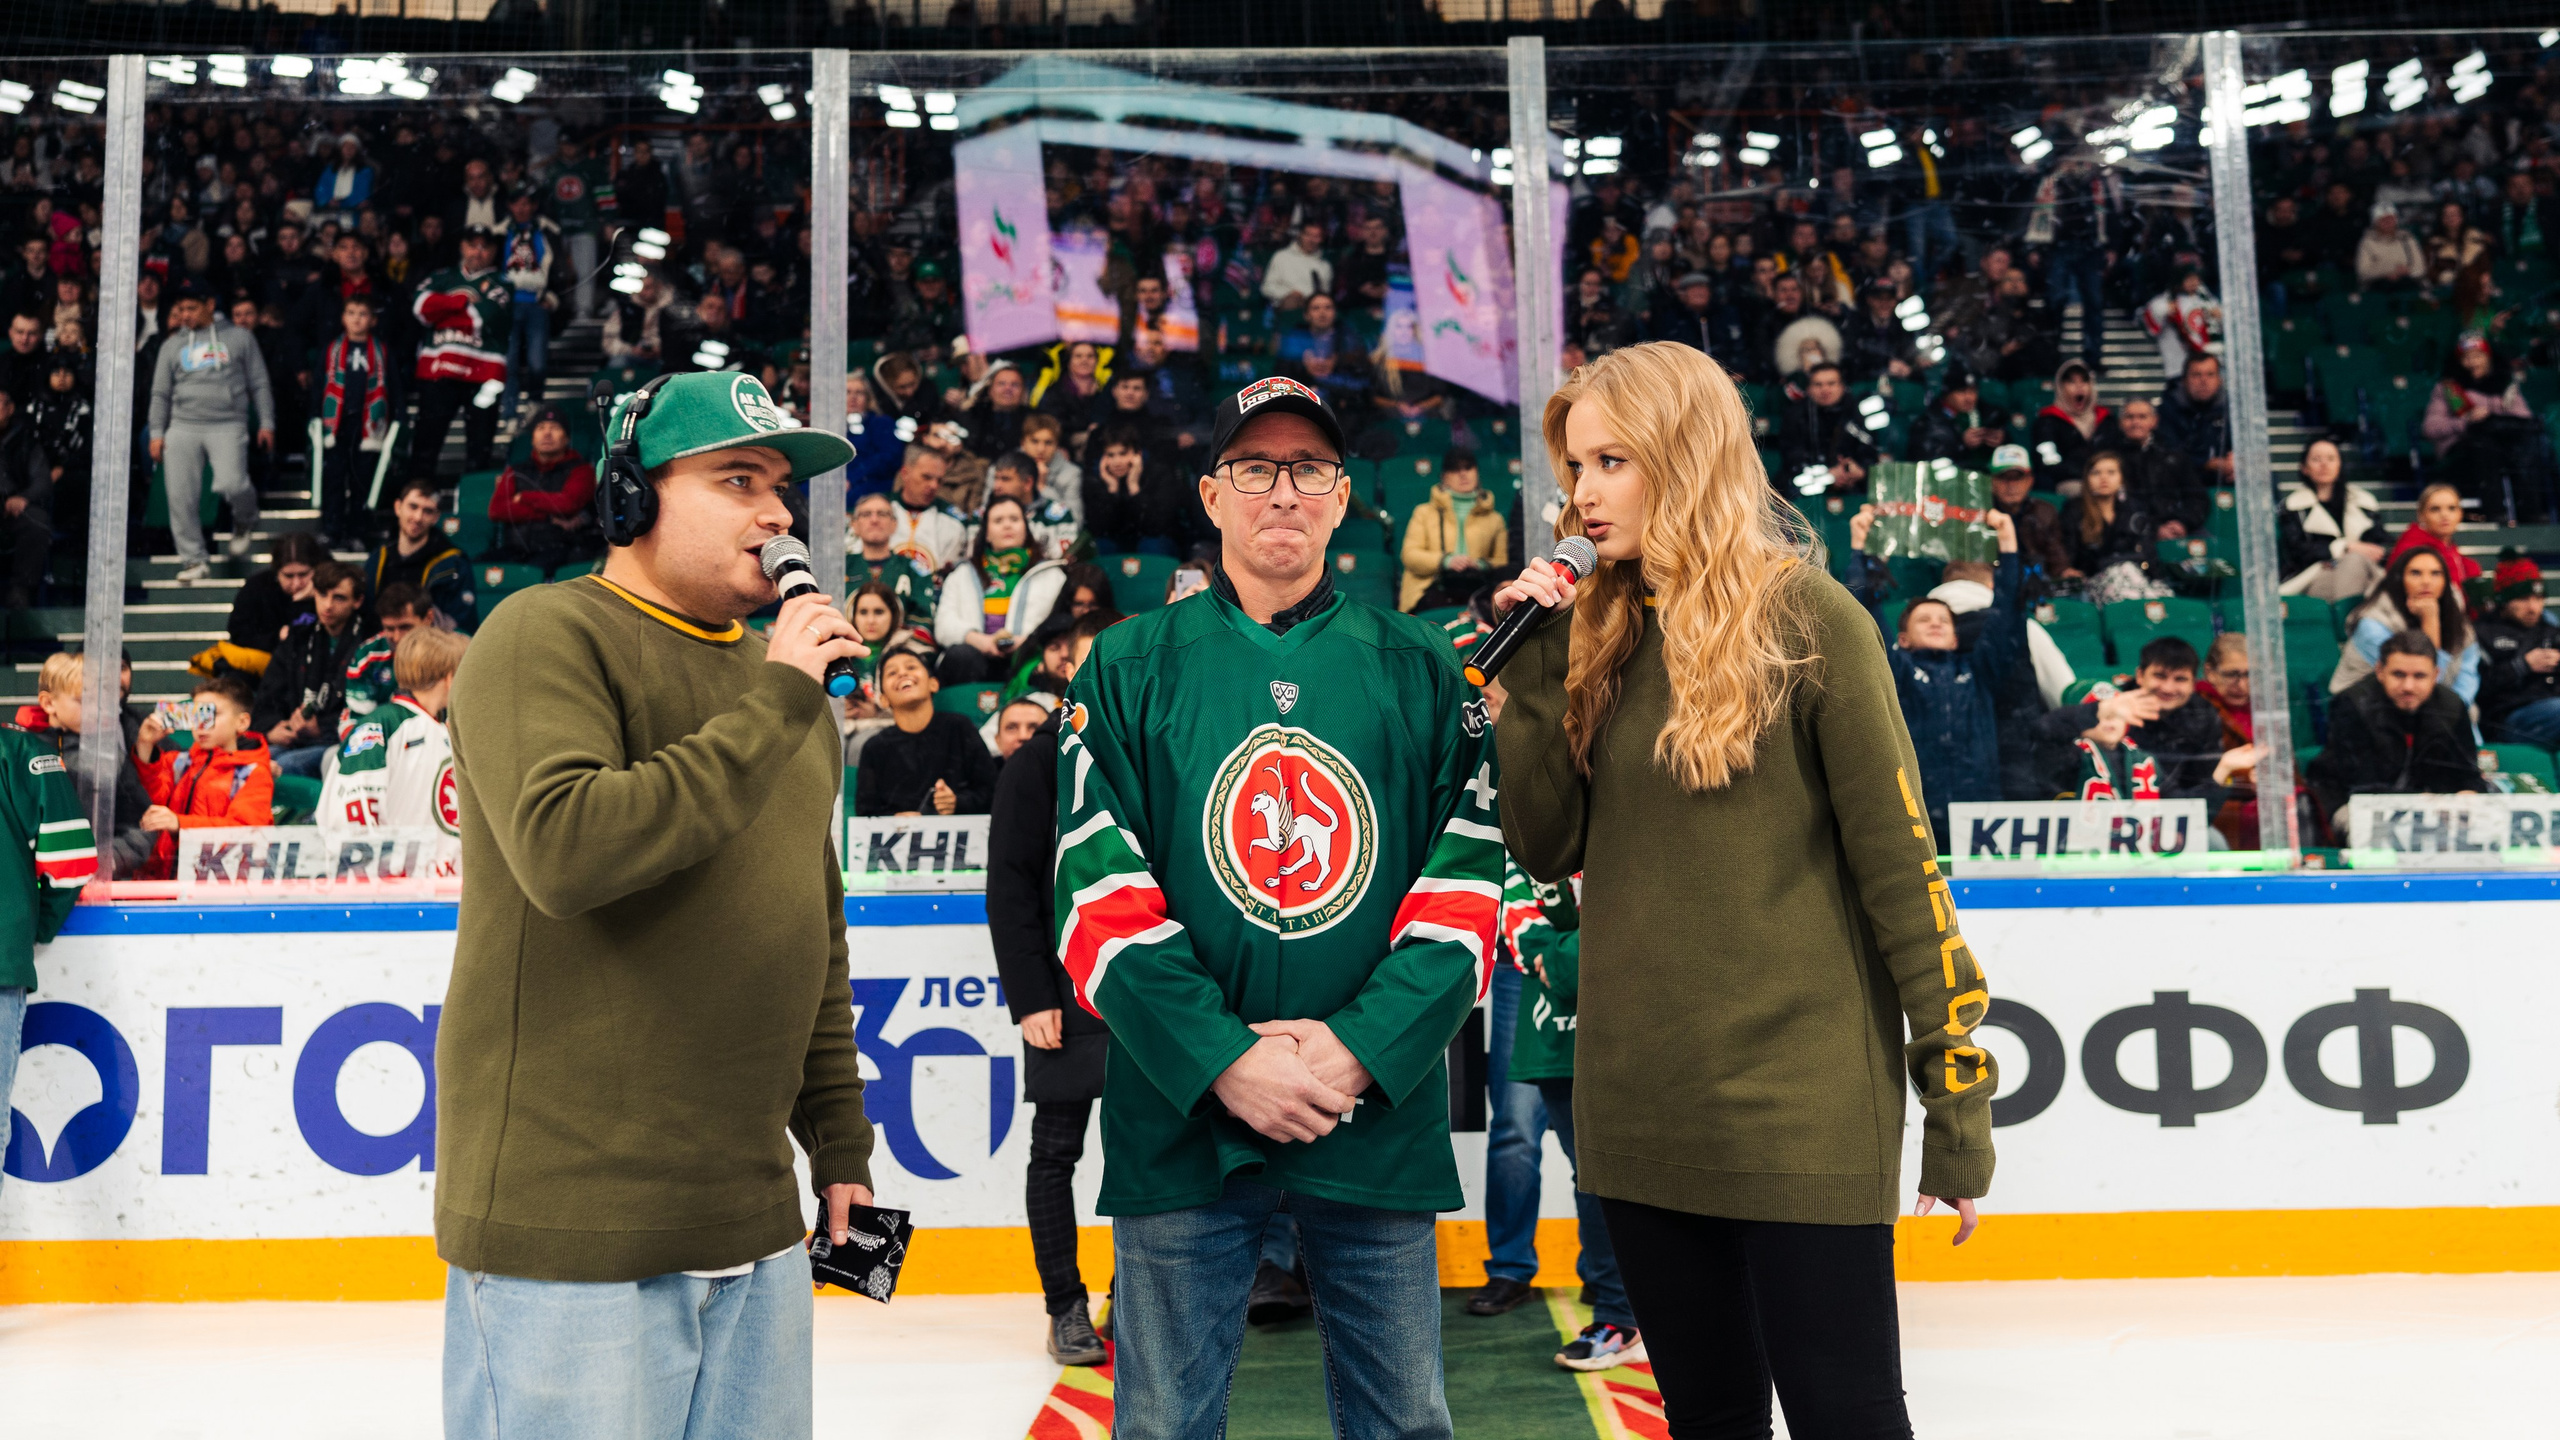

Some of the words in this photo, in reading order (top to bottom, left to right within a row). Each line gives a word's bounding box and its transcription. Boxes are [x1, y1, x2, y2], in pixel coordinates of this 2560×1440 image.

[1969, 816, 2189, 860] KHL.RU
[2370, 810, 2560, 852] KHL.R
[195, 841, 420, 884] KHL.RU
